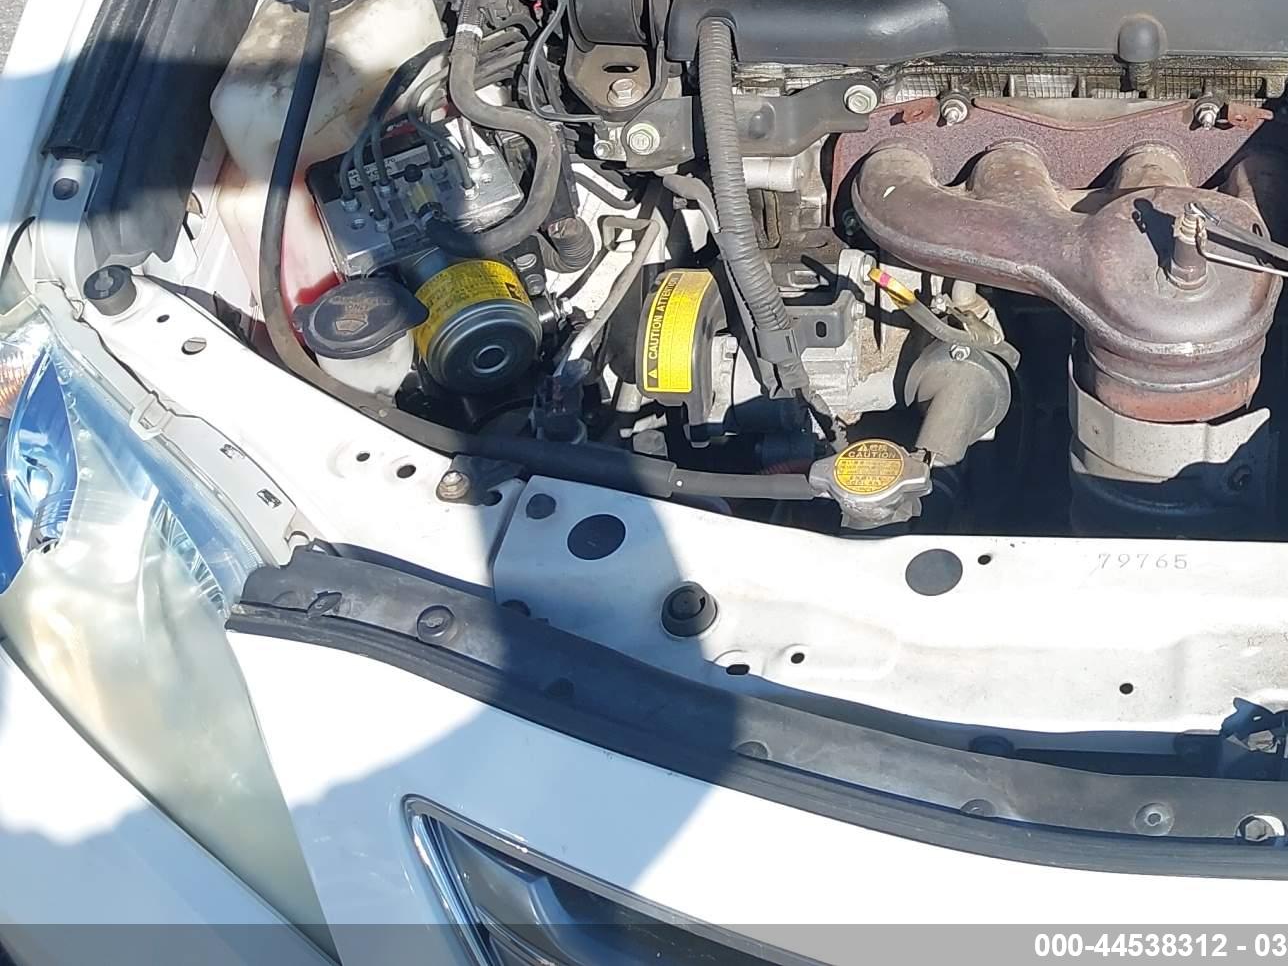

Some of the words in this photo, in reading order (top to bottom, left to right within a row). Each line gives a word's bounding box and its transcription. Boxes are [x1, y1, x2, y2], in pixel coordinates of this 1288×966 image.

[648, 314, 662, 360] CAUTION
[656, 276, 680, 312] ATTENTION
[848, 451, 897, 459] CAUTION
[1098, 553, 1188, 570] 79765
